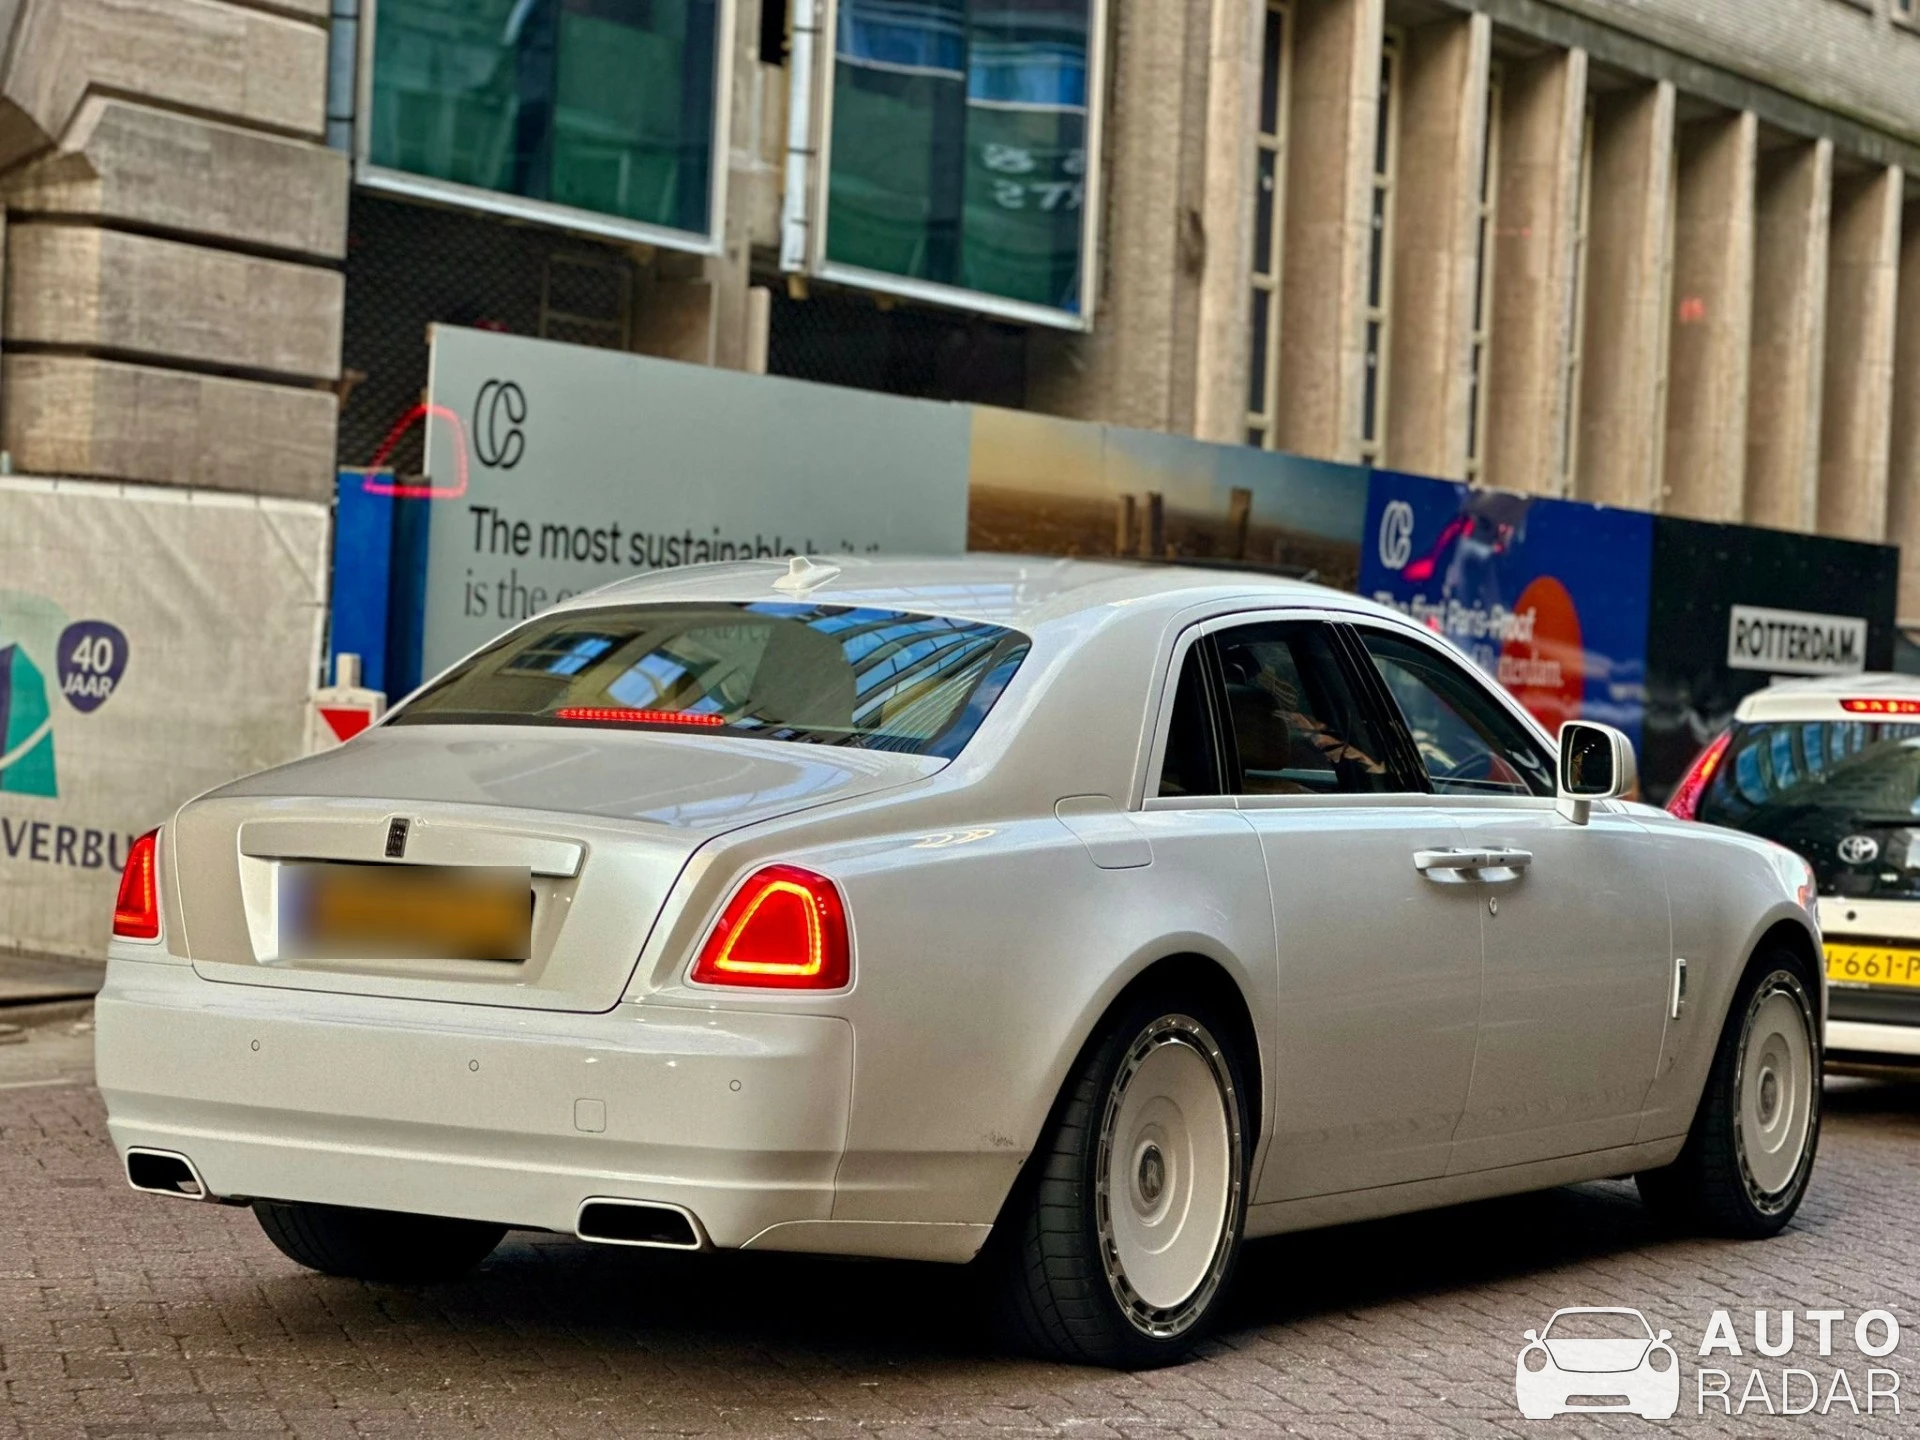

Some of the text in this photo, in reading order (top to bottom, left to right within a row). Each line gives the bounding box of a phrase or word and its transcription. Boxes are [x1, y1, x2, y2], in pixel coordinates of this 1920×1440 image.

[468, 504, 532, 557] The
[539, 521, 622, 567] most
[464, 567, 548, 620] is the
[71, 636, 114, 674] 40
[64, 672, 114, 698] JAAR
